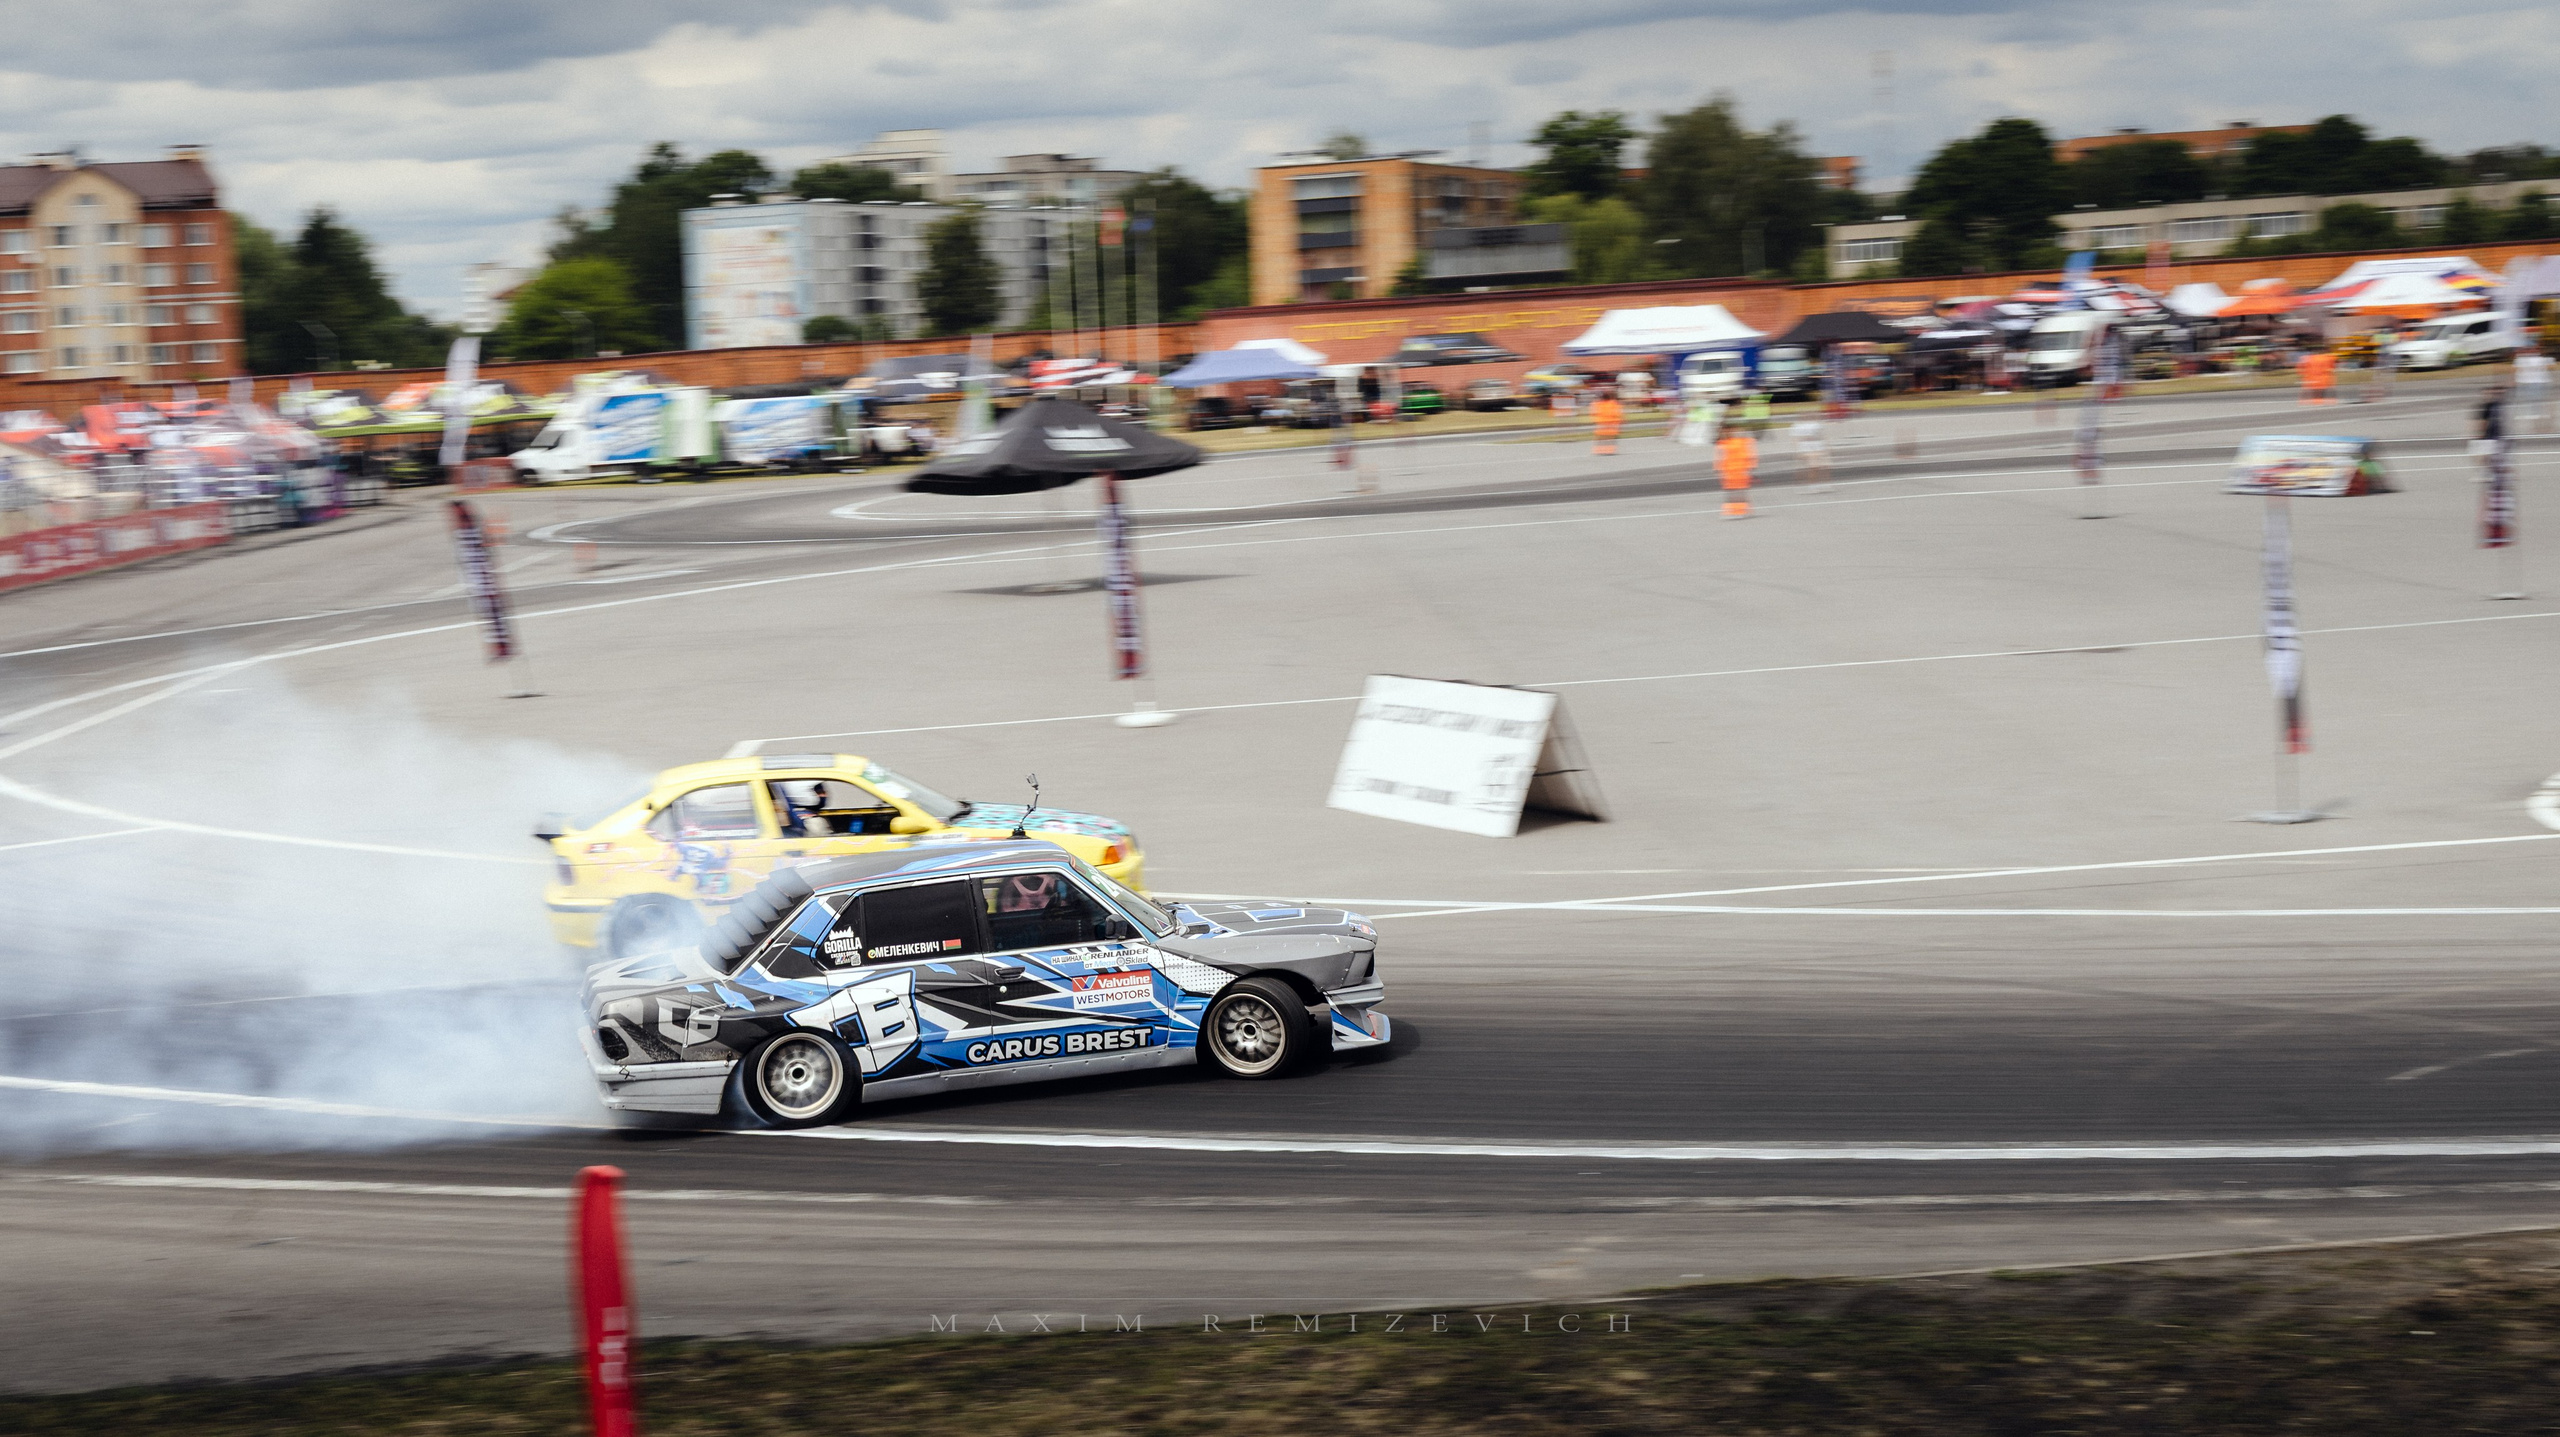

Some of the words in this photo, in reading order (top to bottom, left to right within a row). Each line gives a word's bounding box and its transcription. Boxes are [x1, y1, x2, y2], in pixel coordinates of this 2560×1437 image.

[824, 937, 863, 954] GORILLA
[875, 941, 940, 958] МЕЛЕНКЕВИЧ
[1052, 956, 1060, 964] НА
[1061, 955, 1083, 963] ШИНАХ
[1098, 975, 1150, 988] Valvoline
[1076, 989, 1150, 1004] WESTMOTORS
[968, 1036, 1059, 1063] CARUS
[1067, 1028, 1151, 1053] BREST
